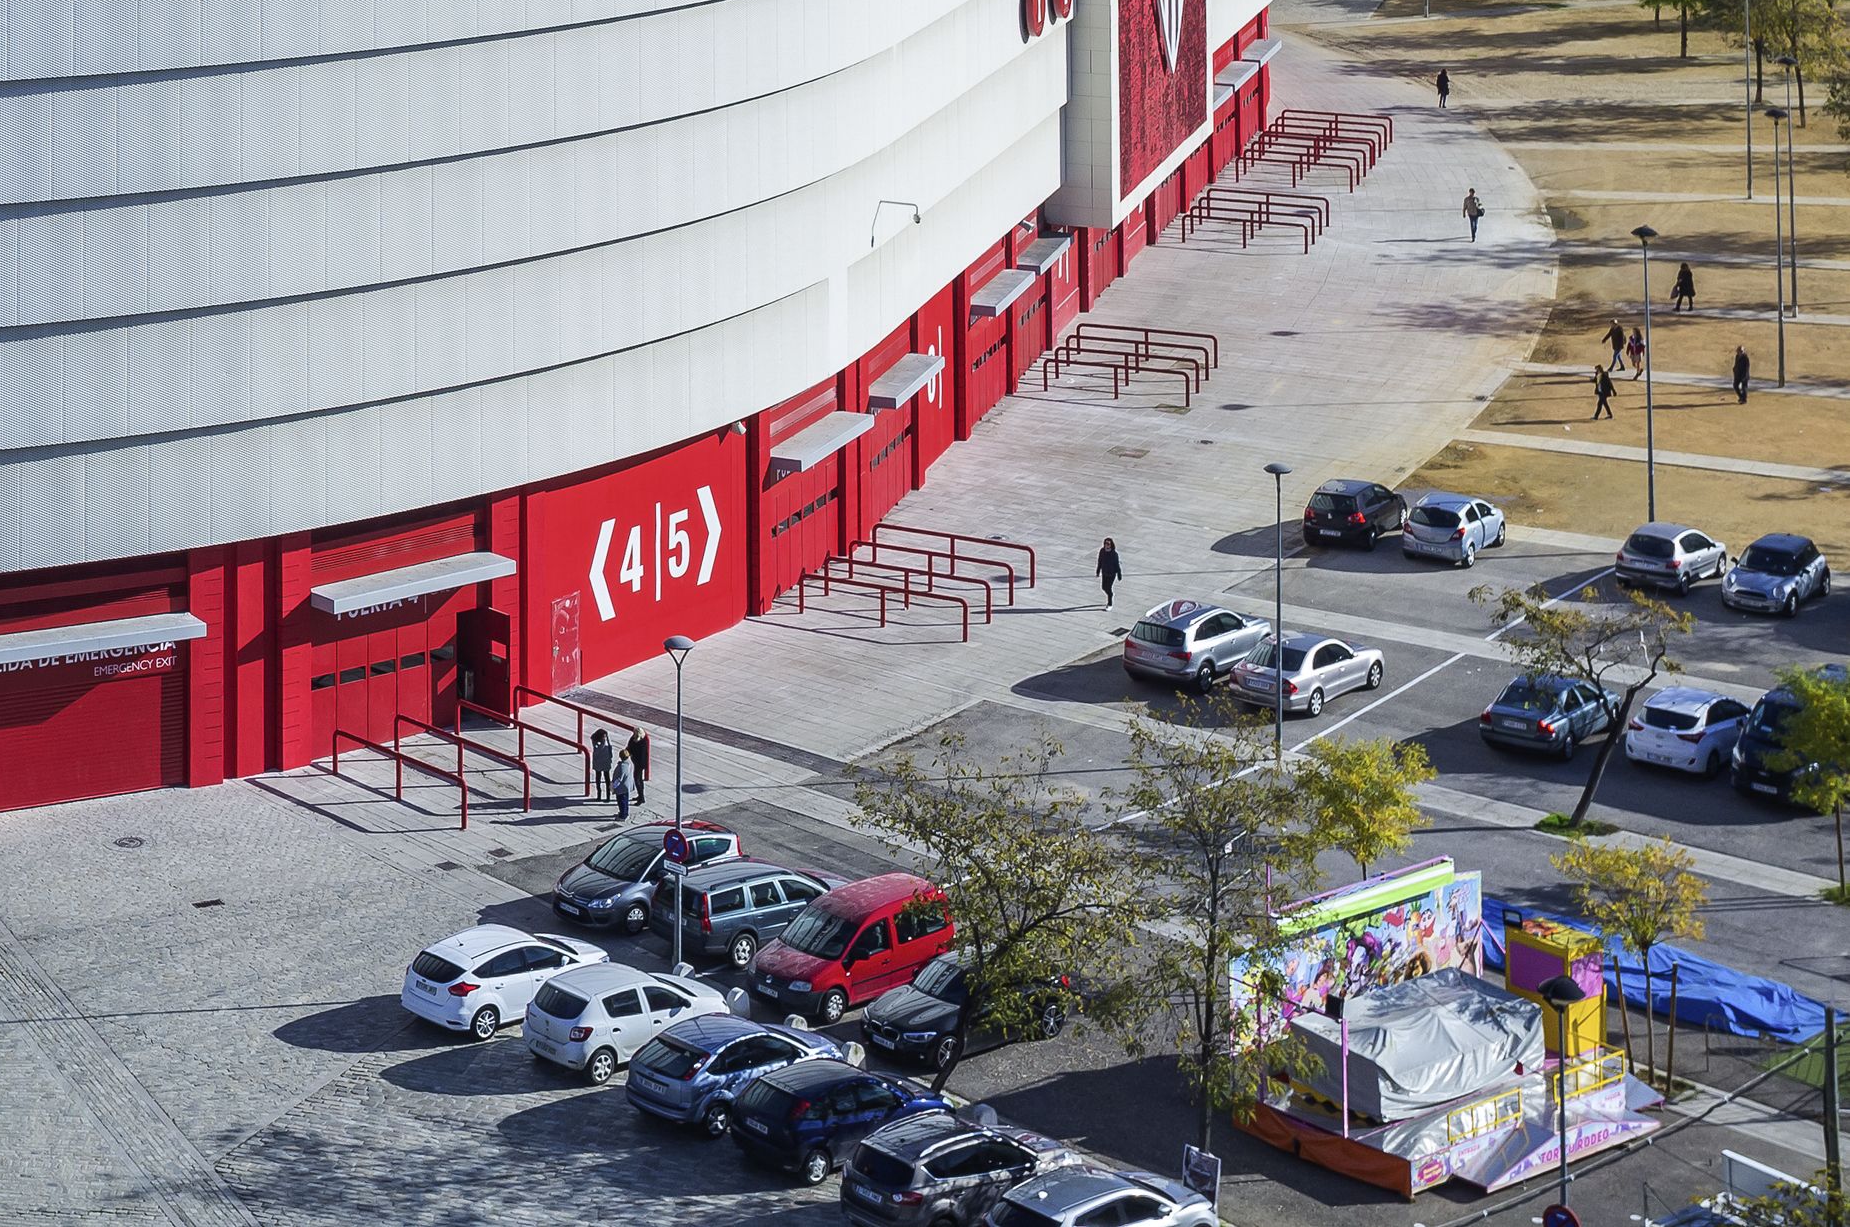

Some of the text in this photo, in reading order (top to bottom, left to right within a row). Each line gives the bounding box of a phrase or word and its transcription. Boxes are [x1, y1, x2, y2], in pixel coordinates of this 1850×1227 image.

[94, 655, 178, 677] EMERGENCY EXIT
[1577, 1128, 1609, 1150] RODEO
